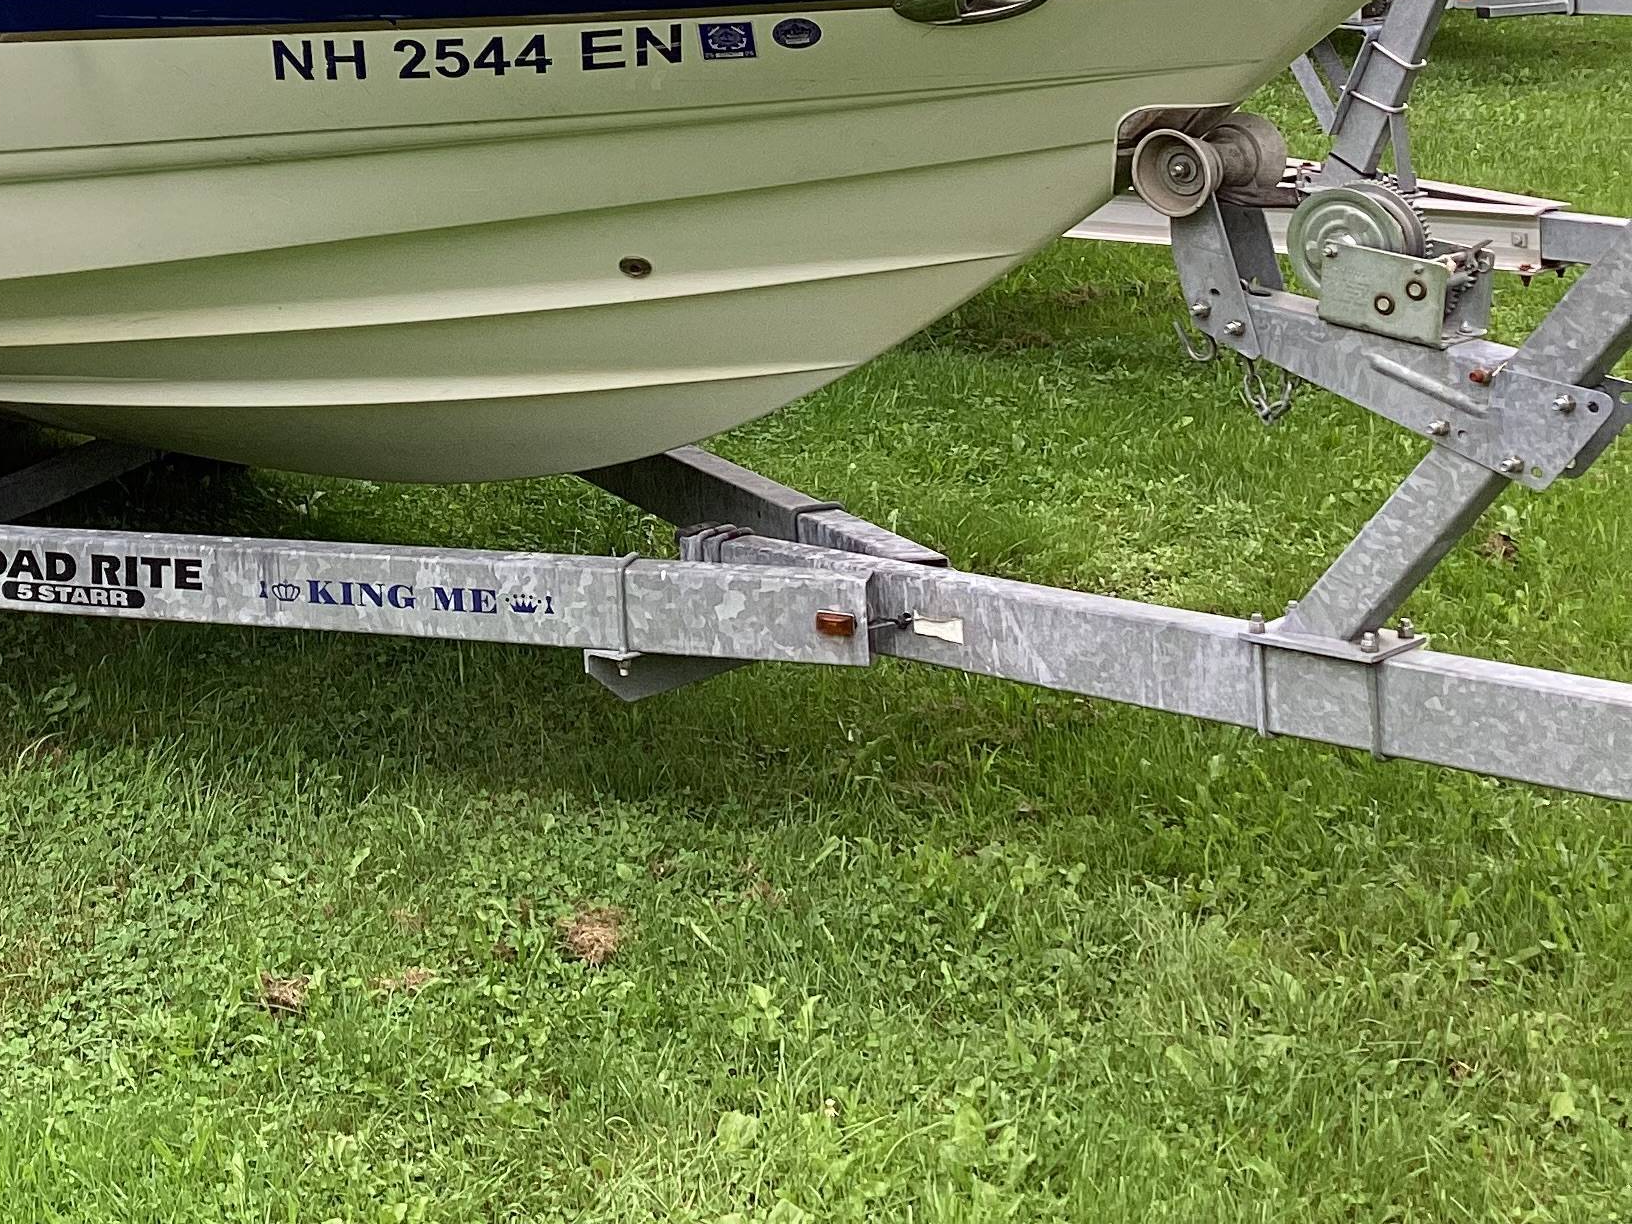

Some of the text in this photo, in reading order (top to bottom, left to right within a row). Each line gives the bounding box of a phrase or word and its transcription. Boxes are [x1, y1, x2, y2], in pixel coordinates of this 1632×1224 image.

[272, 23, 683, 81] NH 2544 EN
[90, 553, 203, 591] RITE
[17, 584, 129, 607] 5 STARR
[305, 579, 498, 614] KING ME
